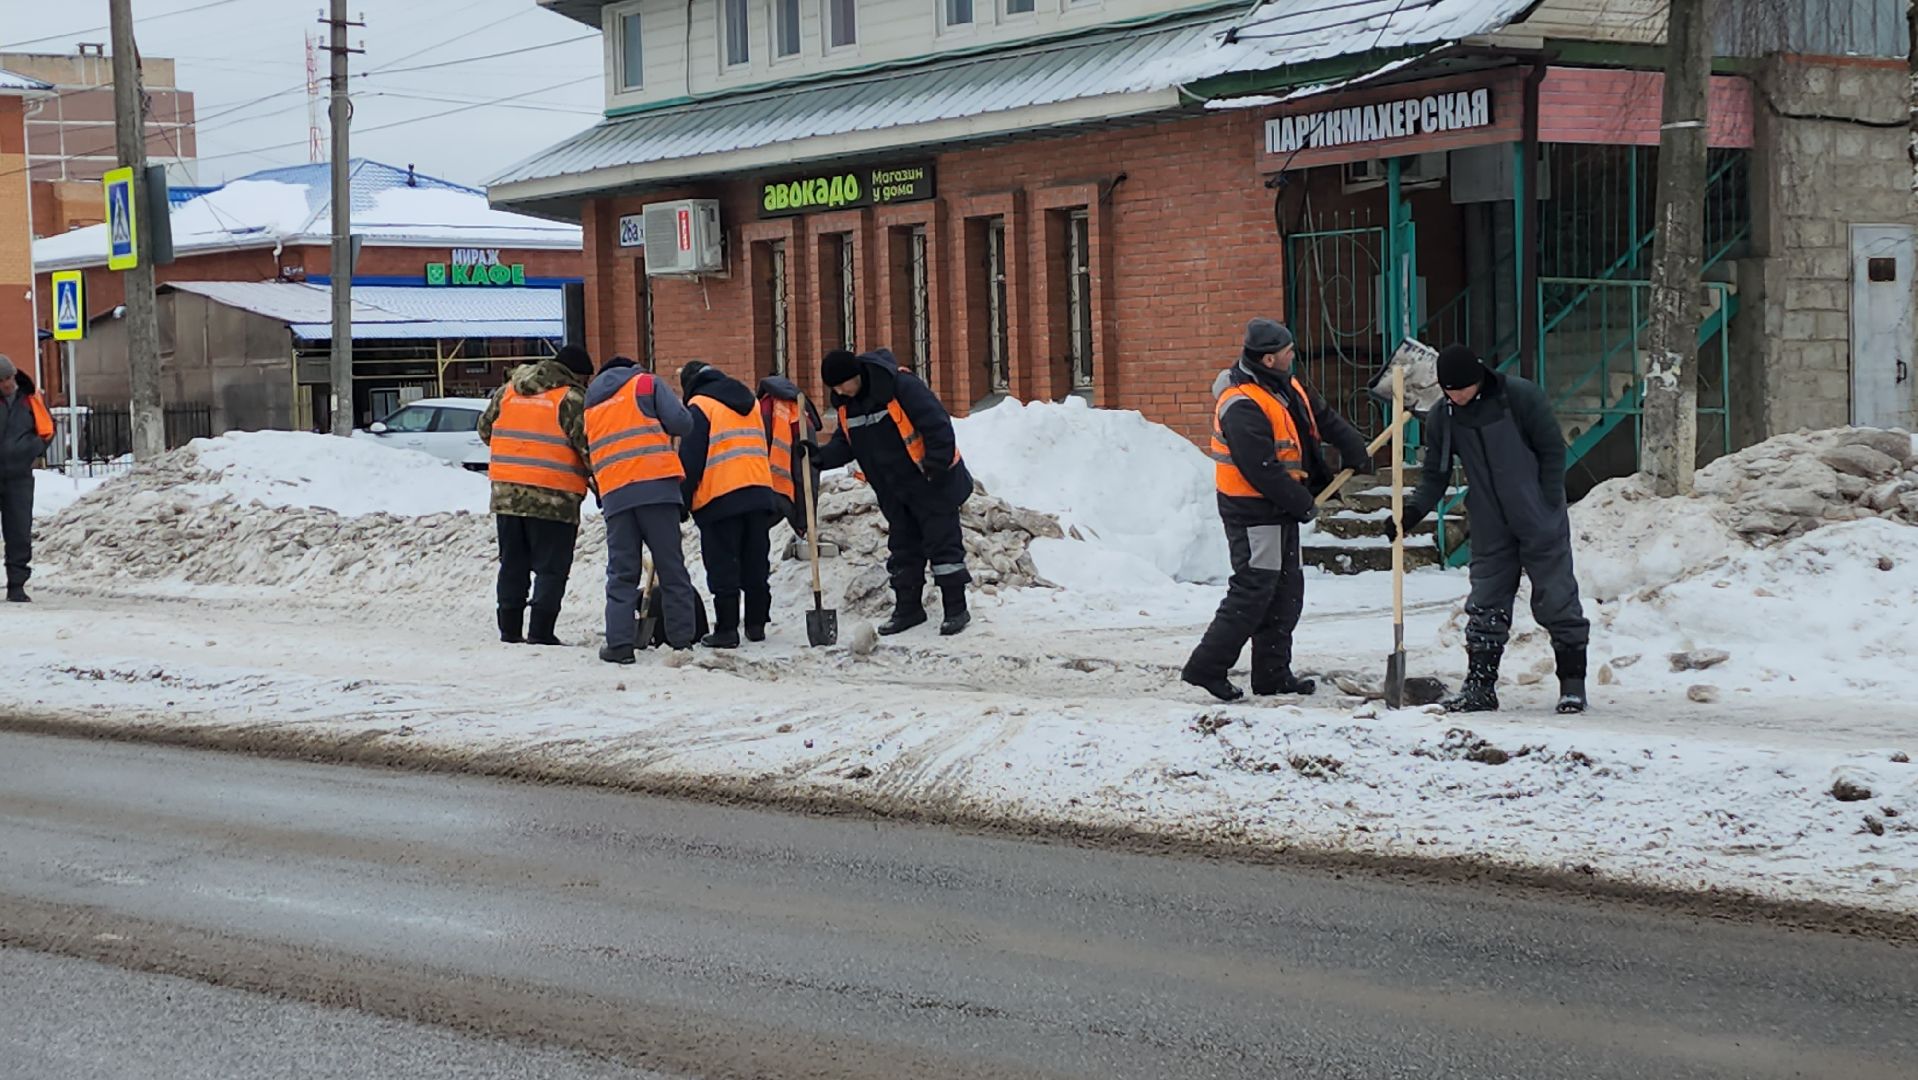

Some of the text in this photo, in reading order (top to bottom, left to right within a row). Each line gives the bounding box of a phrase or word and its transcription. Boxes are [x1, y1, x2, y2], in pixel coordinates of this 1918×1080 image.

[1265, 88, 1489, 153] ПАРИКМАХЕРСКАЯ
[872, 168, 923, 185] Магазин
[873, 184, 913, 202] у дома
[452, 248, 499, 265] МИРАЖ
[452, 264, 525, 285] КАФЕ
